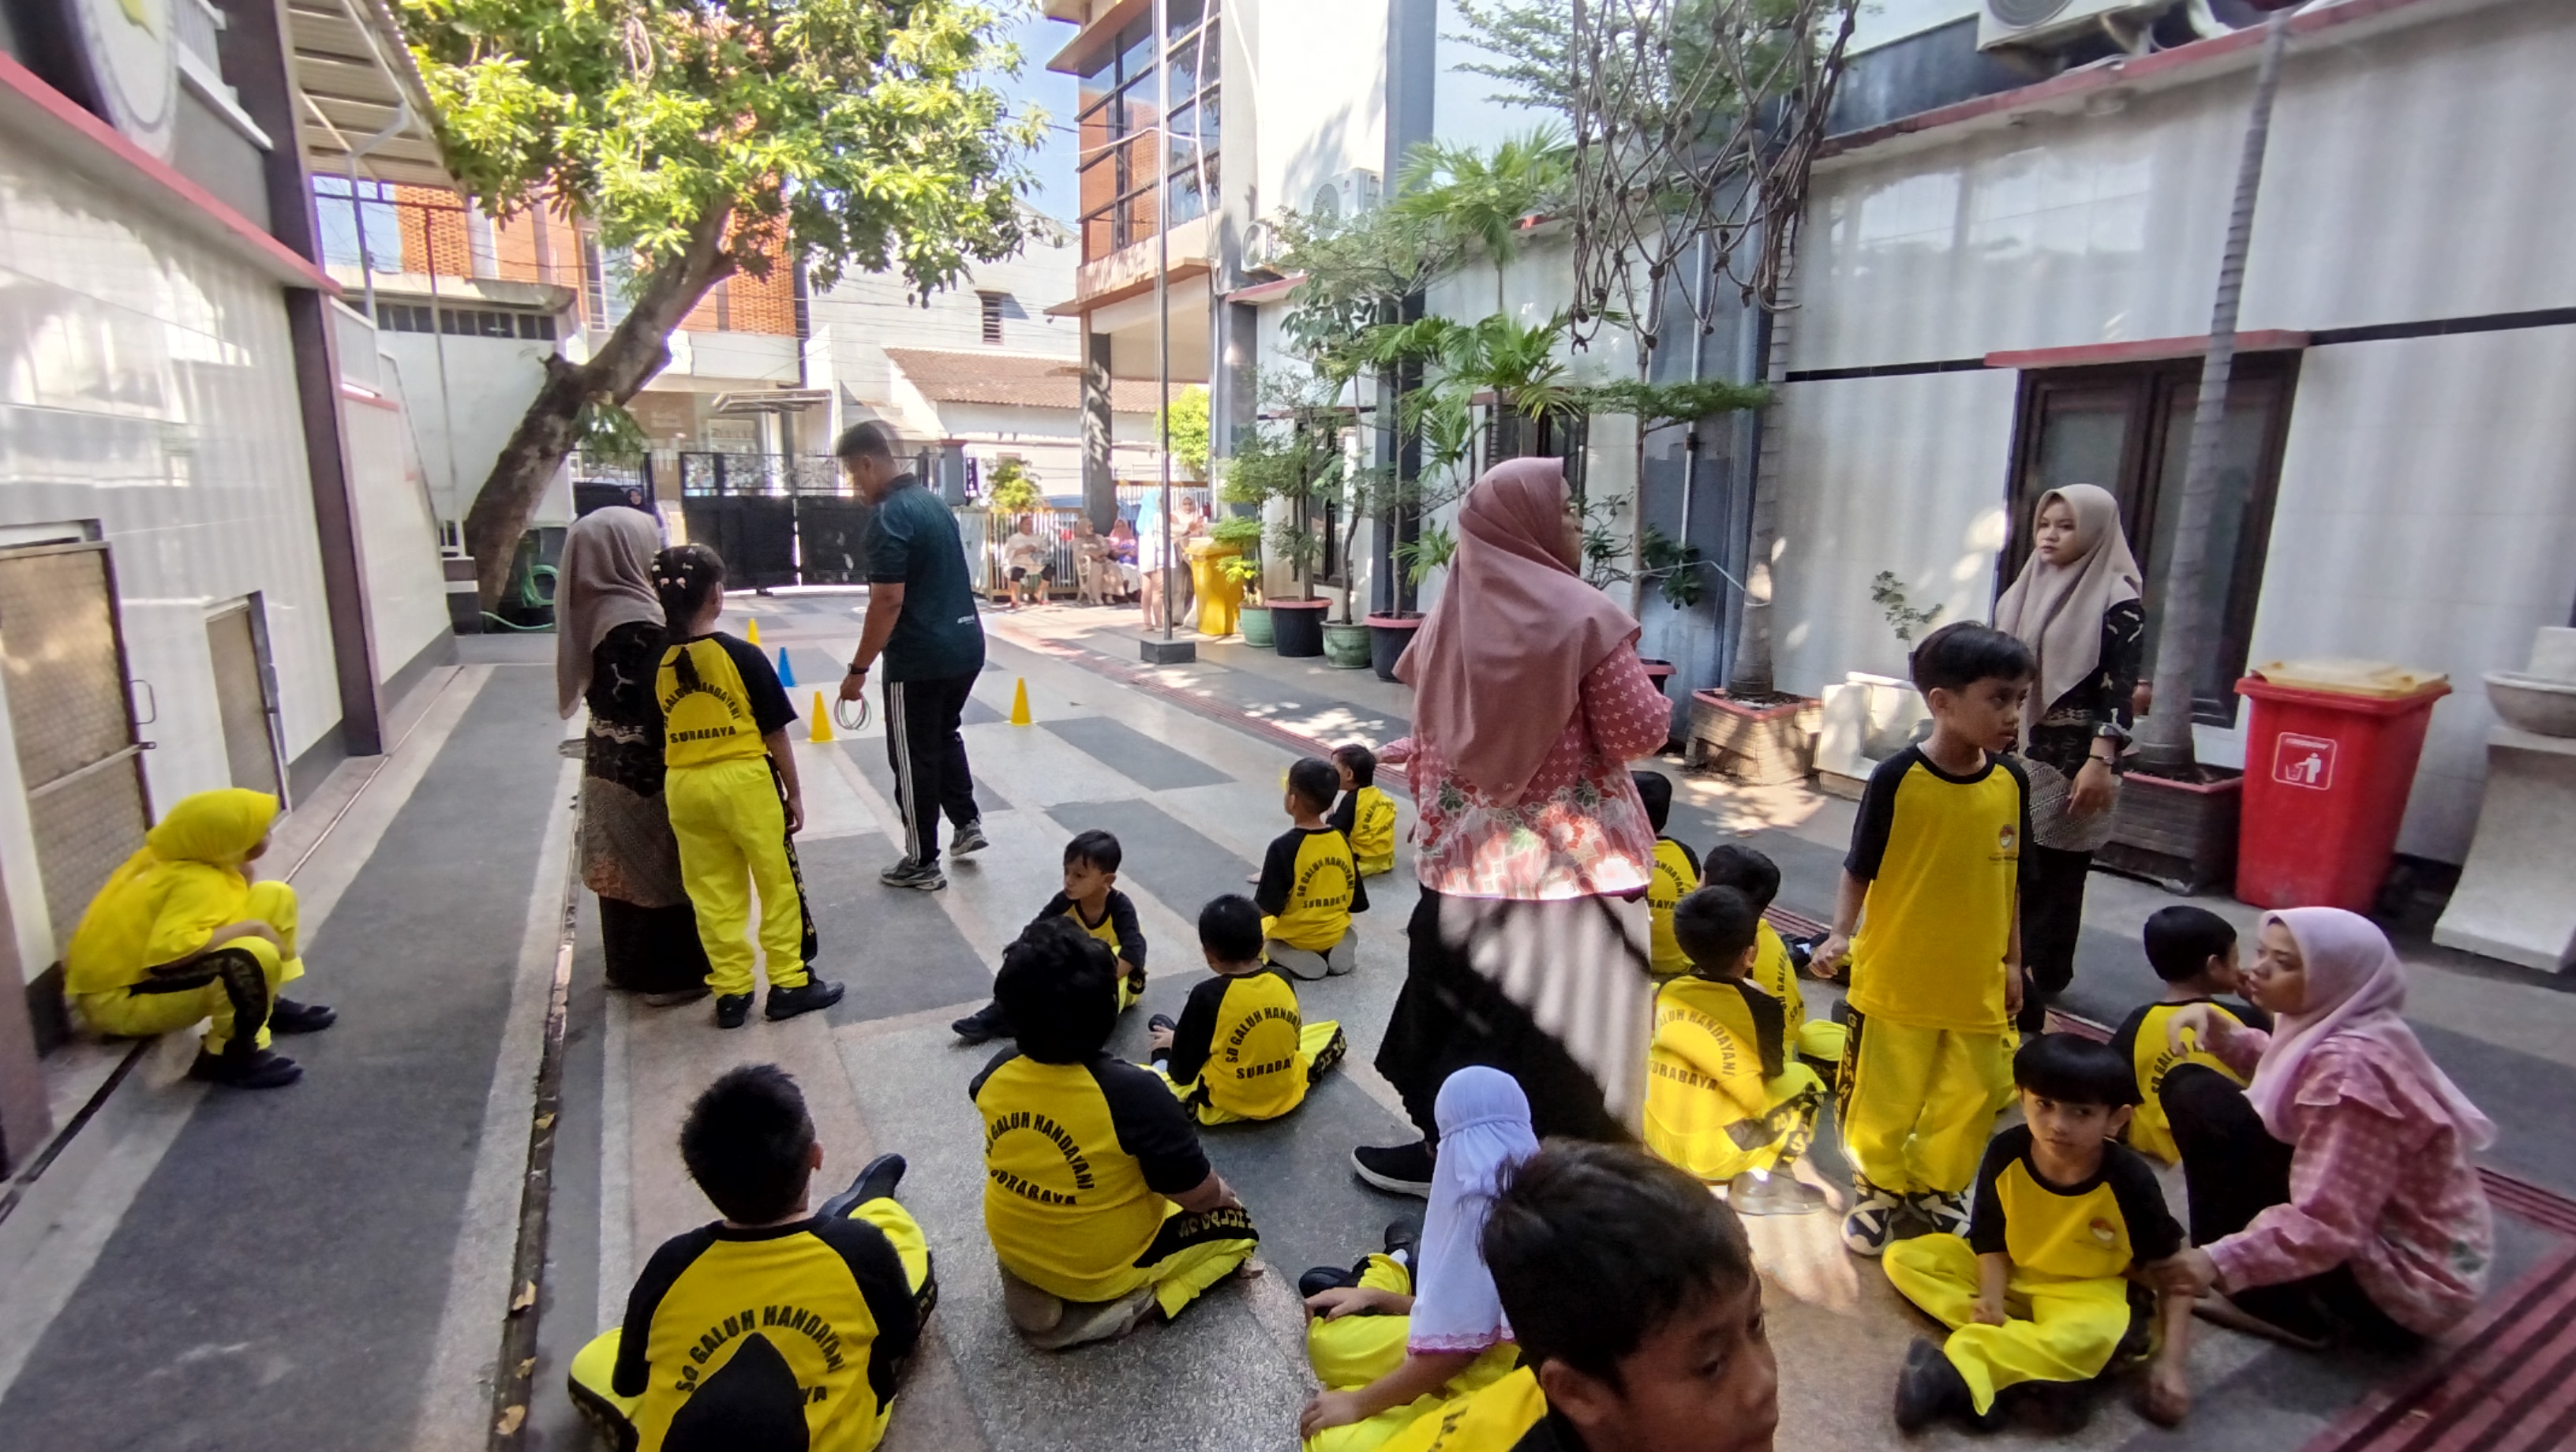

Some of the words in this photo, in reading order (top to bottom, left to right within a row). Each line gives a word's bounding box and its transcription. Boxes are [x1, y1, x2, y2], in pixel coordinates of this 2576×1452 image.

[670, 725, 736, 743] SURABAYA
[1230, 1010, 1264, 1046] GALUH
[1687, 1010, 1735, 1076] HANDAYANI
[1225, 1046, 1239, 1063] SD
[990, 1111, 1030, 1140] GALUH
[1033, 1113, 1095, 1190] HANDAYANI
[675, 1364, 700, 1392] SD
[689, 1308, 756, 1364] GALUH
[763, 1304, 846, 1375] HANDAYANI
